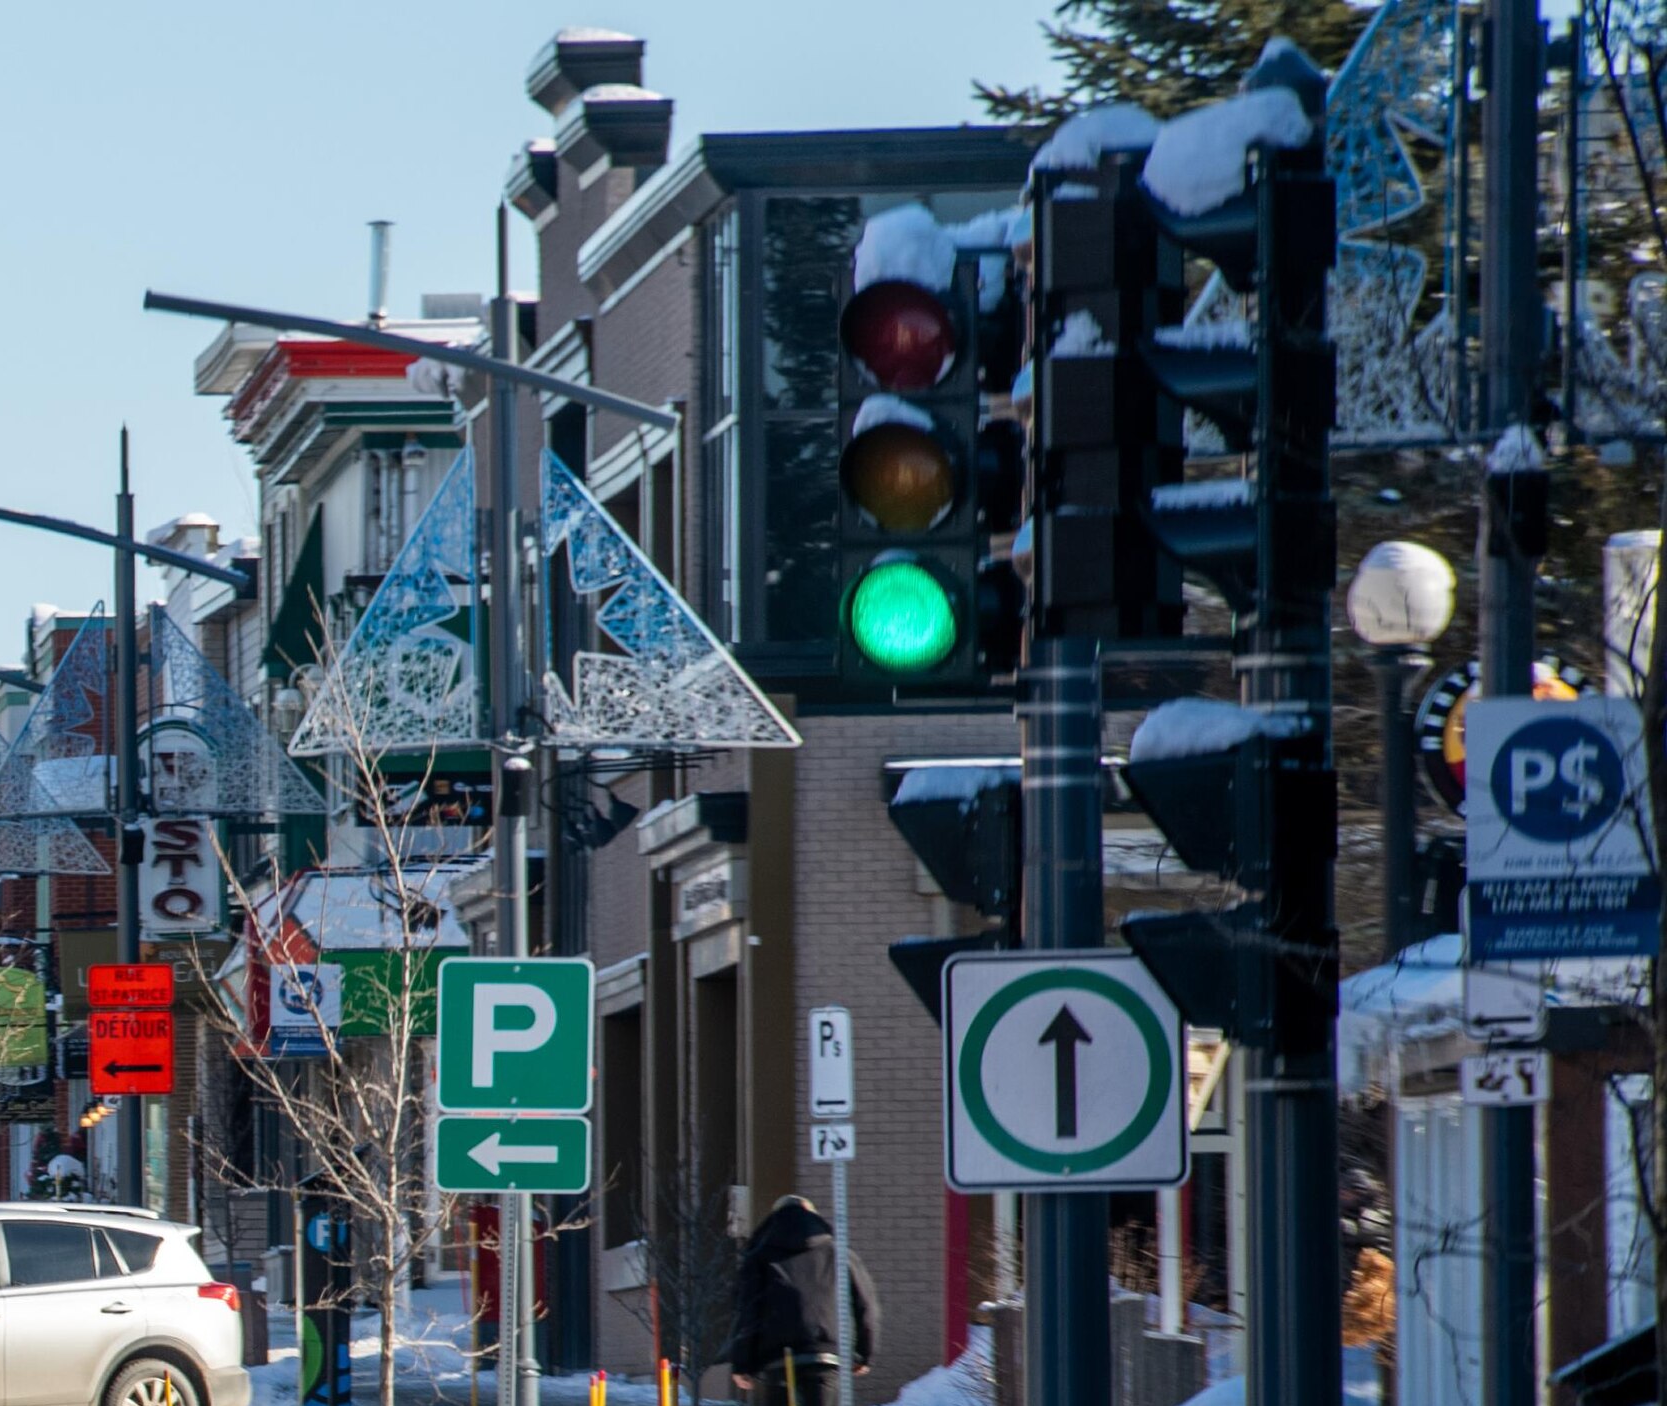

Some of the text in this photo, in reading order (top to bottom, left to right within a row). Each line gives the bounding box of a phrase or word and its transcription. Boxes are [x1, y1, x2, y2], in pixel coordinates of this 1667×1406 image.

[114, 969, 145, 982] RUE
[93, 988, 167, 1001] ST-PATRICE
[95, 1015, 167, 1039] DÉTOUR
[471, 982, 558, 1088] P
